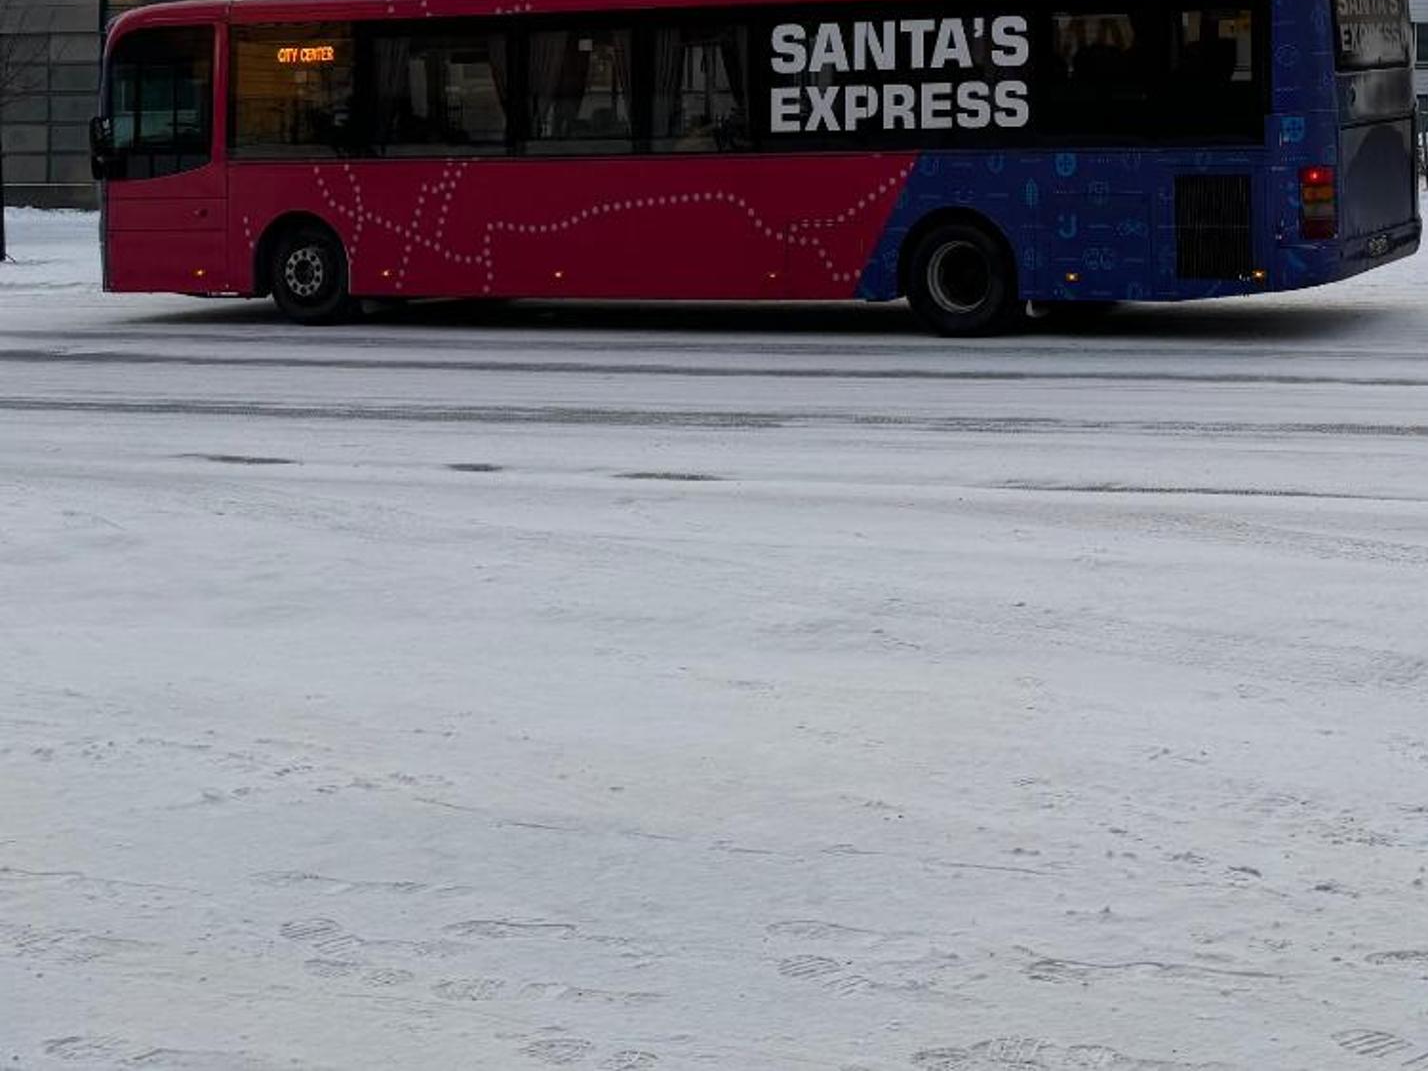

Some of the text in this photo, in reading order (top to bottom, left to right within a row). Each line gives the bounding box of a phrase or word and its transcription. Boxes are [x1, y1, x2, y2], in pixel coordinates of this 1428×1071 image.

[300, 46, 334, 62] CENTER
[771, 16, 1028, 73] SANTA'S
[771, 80, 1029, 132] EXPRESS
